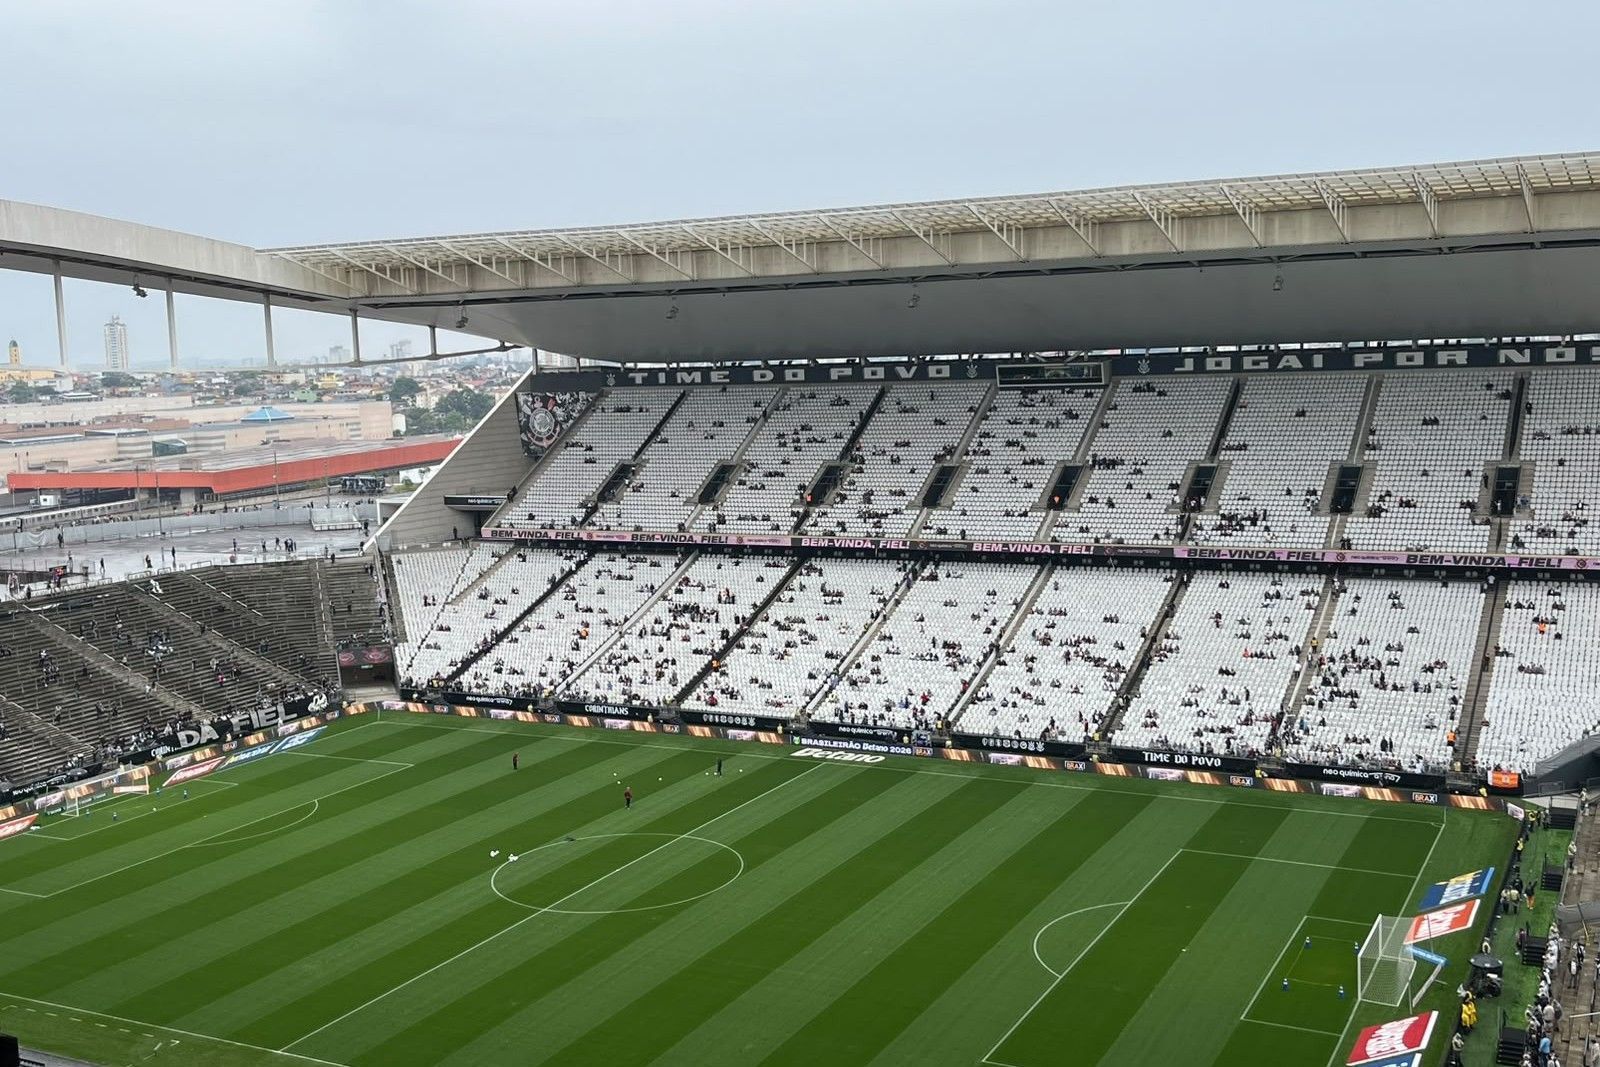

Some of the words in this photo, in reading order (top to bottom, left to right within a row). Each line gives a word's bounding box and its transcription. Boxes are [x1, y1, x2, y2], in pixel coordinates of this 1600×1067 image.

[1174, 353, 1323, 371] JOGAI
[1353, 350, 1468, 367] POR
[628, 370, 730, 384] TIME
[752, 368, 805, 382] DO
[830, 364, 950, 380] POVO
[555, 531, 581, 540] FIEL!
[701, 535, 728, 544] FIEL!
[879, 540, 910, 549] FIEL!
[1060, 545, 1094, 555] FIEL!
[1286, 551, 1325, 562] FIEL!
[1517, 557, 1562, 568] FIEL!
[585, 704, 629, 716] CORINTHIANS
[177, 724, 219, 748] DA
[230, 702, 298, 732] FIEL
[801, 738, 861, 750] BRASILEIRÃO
[862, 742, 889, 752] Betano
[889, 746, 912, 754] 2026
[790, 747, 886, 763] Betano
[1142, 751, 1170, 763] TIME
[1174, 754, 1188, 764] DO
[1191, 755, 1221, 767] POVO
[1414, 793, 1436, 803] BRAX
